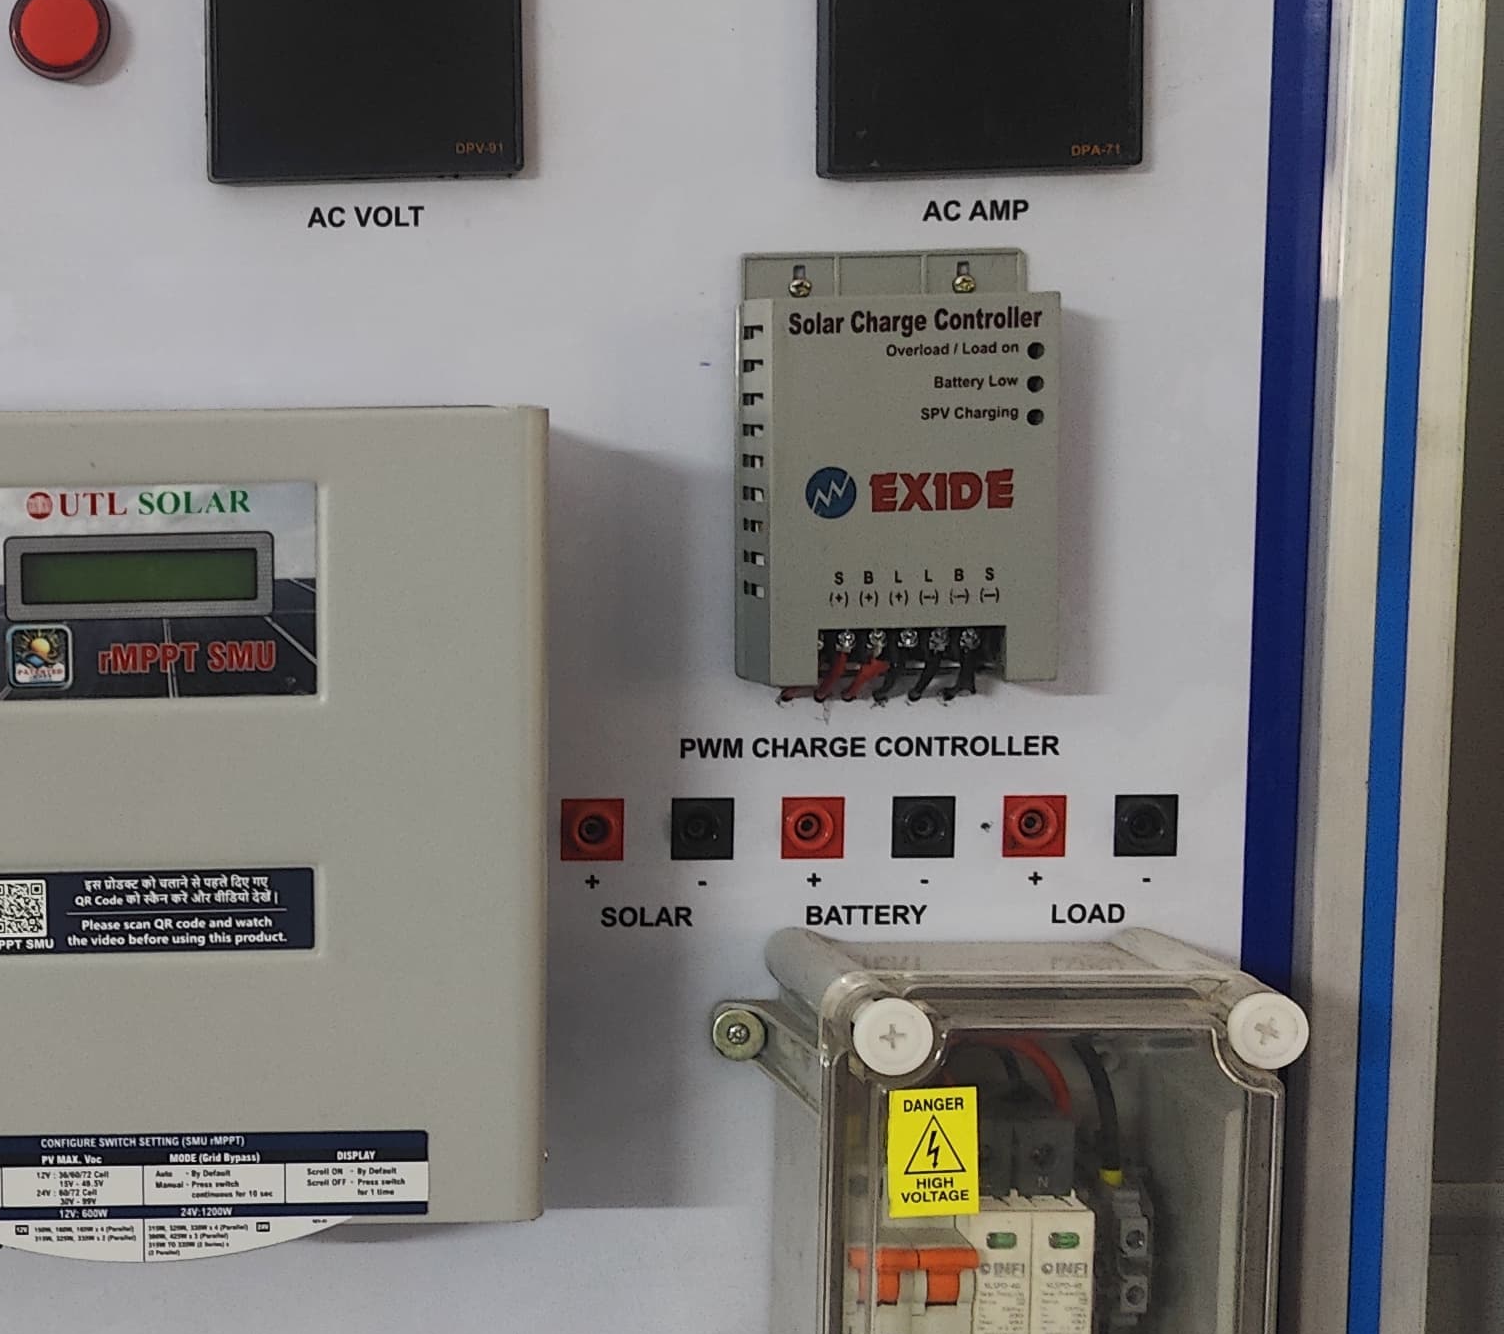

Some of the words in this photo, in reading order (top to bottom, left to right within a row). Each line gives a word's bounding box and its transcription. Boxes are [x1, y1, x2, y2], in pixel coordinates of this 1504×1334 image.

[1070, 143, 1122, 158] DPA-71
[307, 206, 351, 228] AC
[355, 205, 425, 228] VOLT
[922, 200, 965, 222] AC
[968, 199, 1030, 221] AMP
[788, 312, 845, 336] Solar
[850, 310, 928, 338] Charge
[933, 305, 1043, 331] Controller
[886, 342, 950, 357] Overload
[962, 341, 999, 355] Load
[1001, 342, 1020, 354] on
[934, 375, 984, 391] Battery
[989, 375, 1019, 388] Low
[920, 407, 951, 420] SPV
[954, 405, 1020, 421] Charging
[868, 468, 1015, 513] EXIDE
[58, 490, 128, 518] UTL
[137, 489, 252, 515] SOLAR
[833, 571, 845, 586] S
[862, 570, 874, 585] B
[894, 569, 903, 584] L
[924, 568, 933, 583] L
[953, 568, 965, 583] B
[984, 566, 996, 582] S
[98, 641, 201, 675] rMPPT
[207, 640, 277, 671] SMU
[679, 737, 744, 760] PWM
[750, 736, 867, 759] CHARGE
[874, 734, 1060, 758] CONTROLLER
[74, 896, 93, 907] QR
[95, 895, 123, 906] Code
[600, 905, 694, 928] SOLAR
[805, 904, 928, 927] BATTERY
[1051, 903, 1127, 925] LOAD
[81, 919, 121, 932] Please
[123, 920, 152, 931] scan
[154, 918, 174, 930] QR
[176, 918, 206, 929] code
[208, 917, 233, 929] and
[235, 916, 273, 928] watch
[25, 938, 54, 950] SMU
[67, 935, 88, 947] the
[90, 934, 125, 947] video
[128, 933, 170, 946] before
[172, 934, 206, 947] using
[208, 933, 232, 945] this
[234, 932, 288, 947] product.
[903, 1097, 965, 1113] DANGER
[40, 1138, 97, 1148] CONFIGURE
[98, 1137, 137, 1148] SWITCH
[138, 1136, 179, 1147] SETTING
[181, 1136, 208, 1148] (SMU
[209, 1135, 245, 1147] rMPPT)
[41, 1155, 55, 1165] PV
[83, 1154, 103, 1164] Voc
[169, 1153, 197, 1163] MODE
[198, 1152, 222, 1164] (Grid
[223, 1152, 261, 1164] Bypass)
[336, 1150, 377, 1161] DISPLAY
[916, 1177, 954, 1190] HIGH
[901, 1189, 970, 1204] VOLTAGE
[81, 1208, 108, 1218] 600W
